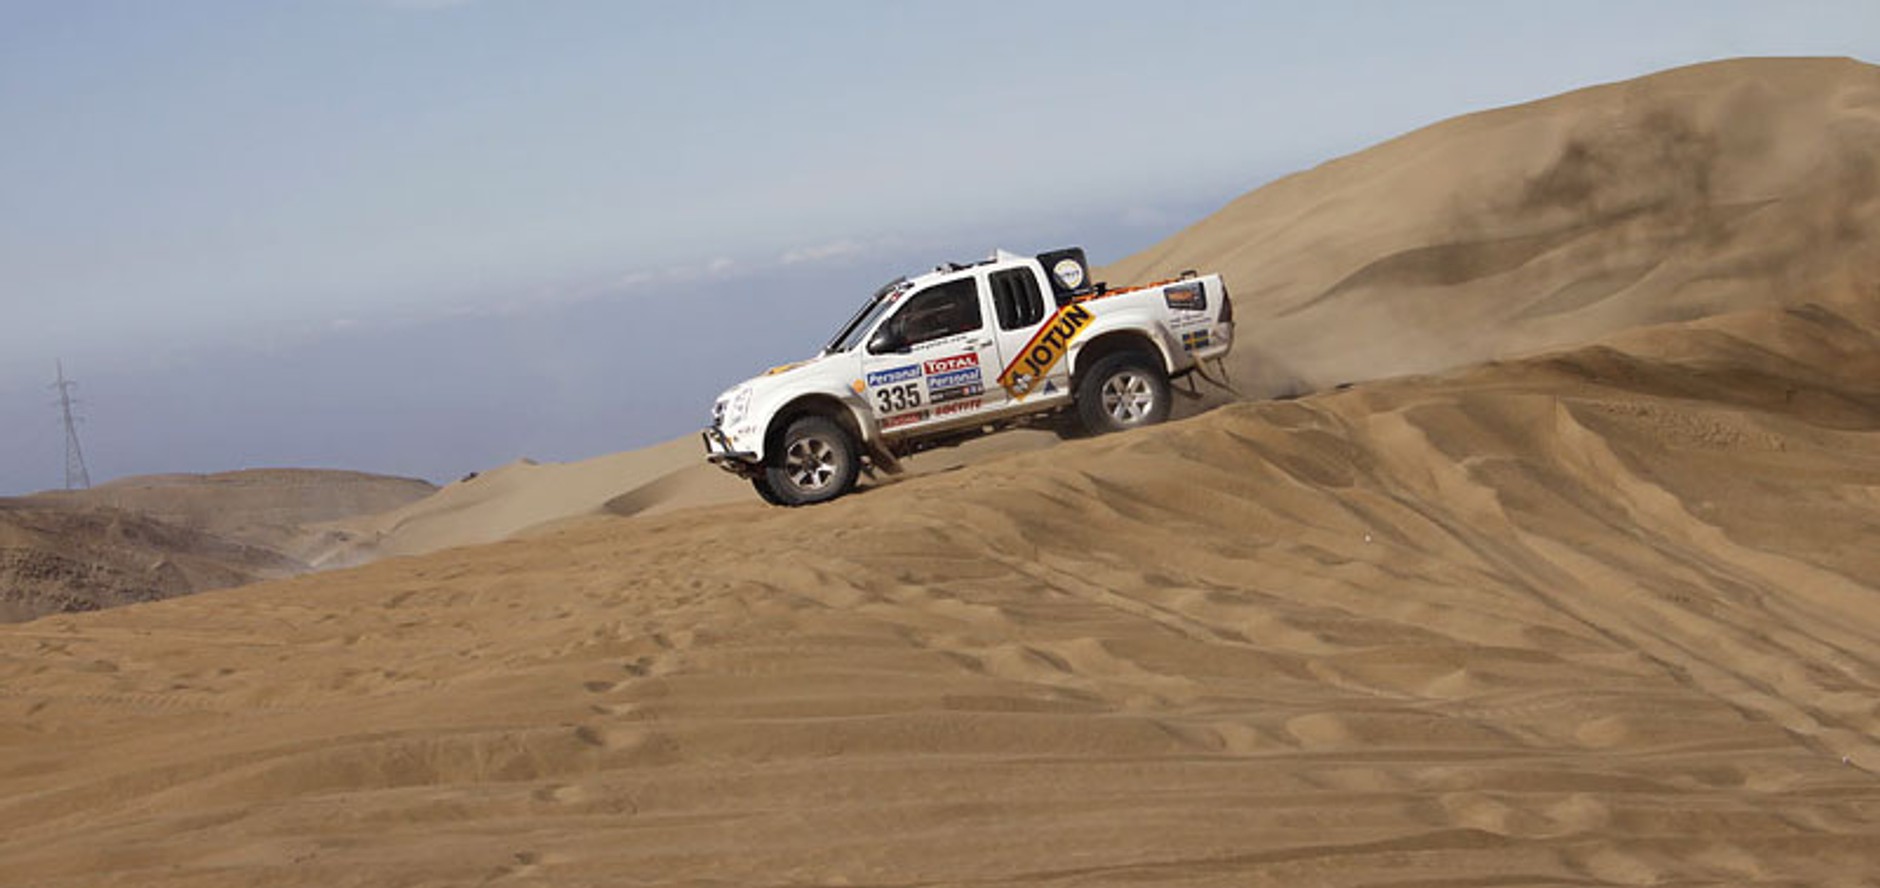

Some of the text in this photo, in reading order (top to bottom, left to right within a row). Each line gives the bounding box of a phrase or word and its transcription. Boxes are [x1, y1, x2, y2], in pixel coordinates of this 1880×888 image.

[1024, 304, 1089, 376] JOTUN
[927, 357, 976, 373] TOTAL
[930, 368, 979, 387] Personal
[877, 383, 921, 413] 335
